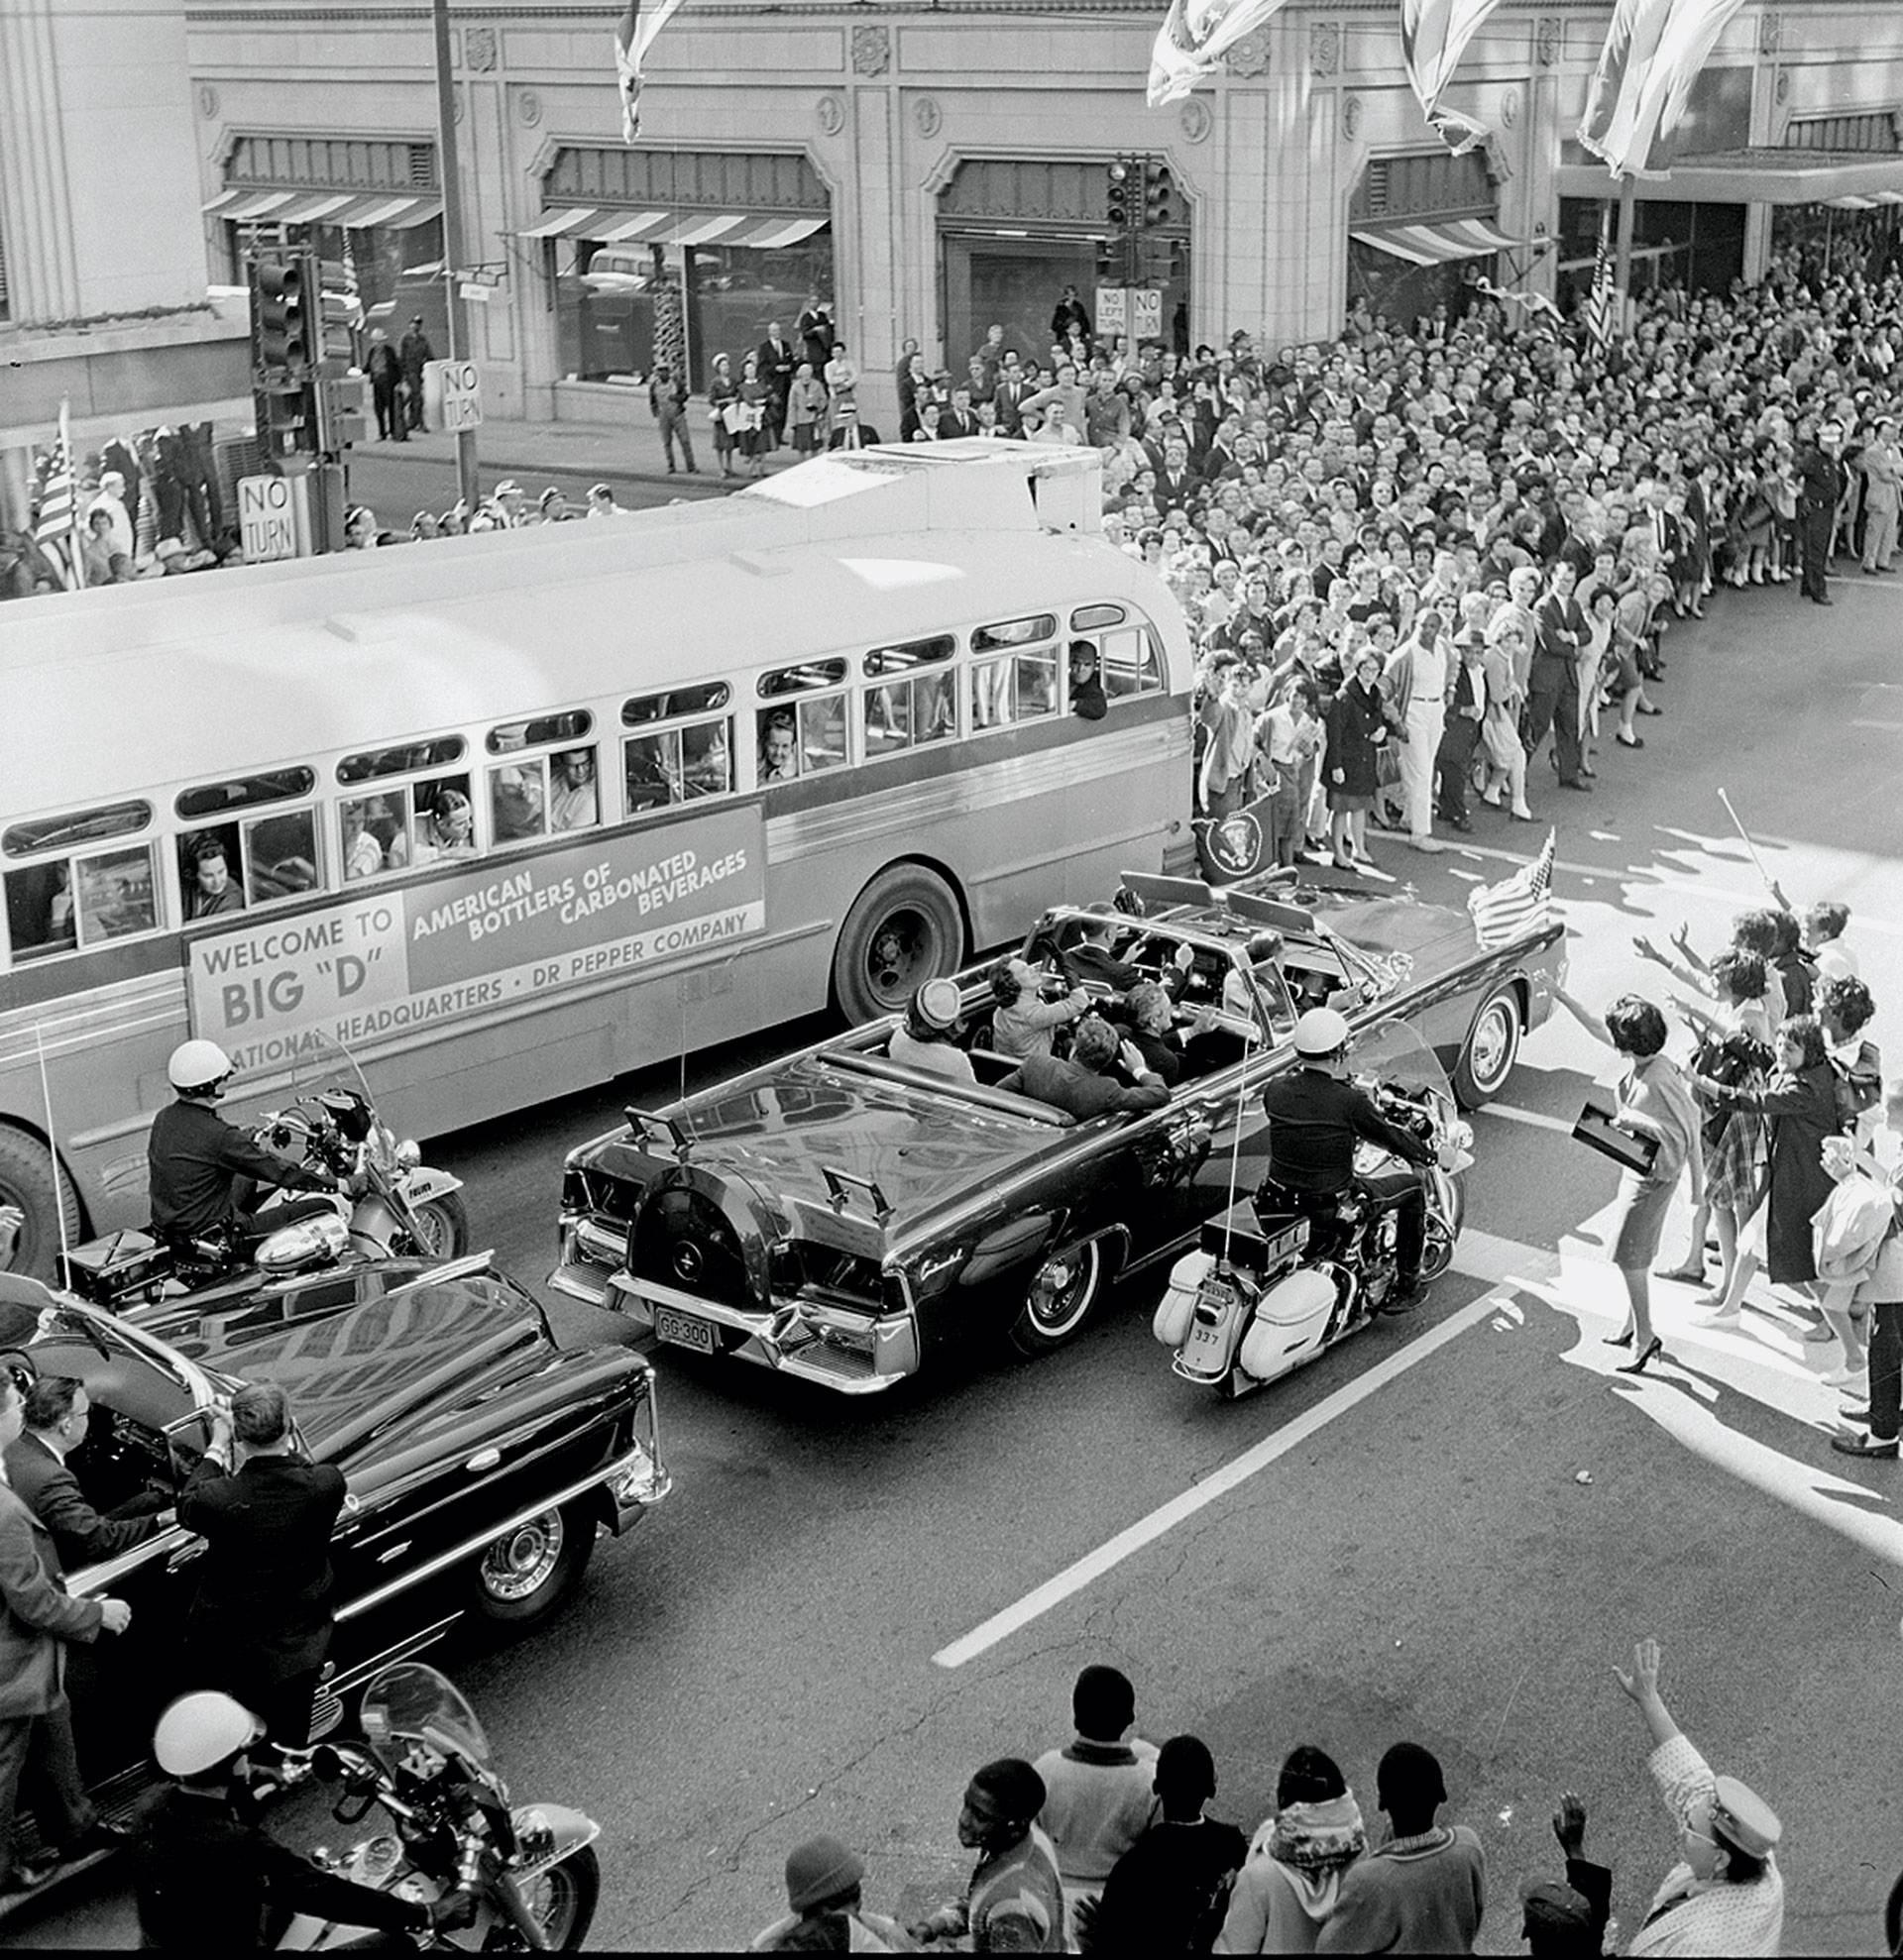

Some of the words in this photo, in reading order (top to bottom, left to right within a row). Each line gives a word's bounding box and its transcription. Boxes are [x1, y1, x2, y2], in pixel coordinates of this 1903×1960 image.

[1099, 306, 1123, 317] LEFT
[1103, 292, 1119, 305] NO
[1135, 292, 1159, 311] NO
[445, 366, 478, 393] NO
[445, 397, 481, 427] TURN
[245, 481, 287, 513] NO
[245, 517, 291, 555] TURN
[468, 878, 576, 941] BOTTLERS
[583, 862, 612, 891] OF
[560, 850, 697, 925] CARBONATED
[637, 849, 747, 916] BEVERAGES
[412, 870, 533, 940] AMERICAN
[203, 919, 344, 976] WELCOME
[355, 908, 392, 937] TO
[222, 970, 304, 1029] BIG
[316, 946, 383, 998] "D"
[231, 1028, 326, 1071] ATIONAL
[336, 978, 504, 1041] HEADQUARTERS
[532, 963, 561, 988] DR
[571, 940, 644, 977] PEPPER
[653, 912, 747, 954] COMPANY
[1194, 1329, 1219, 1346] 337
